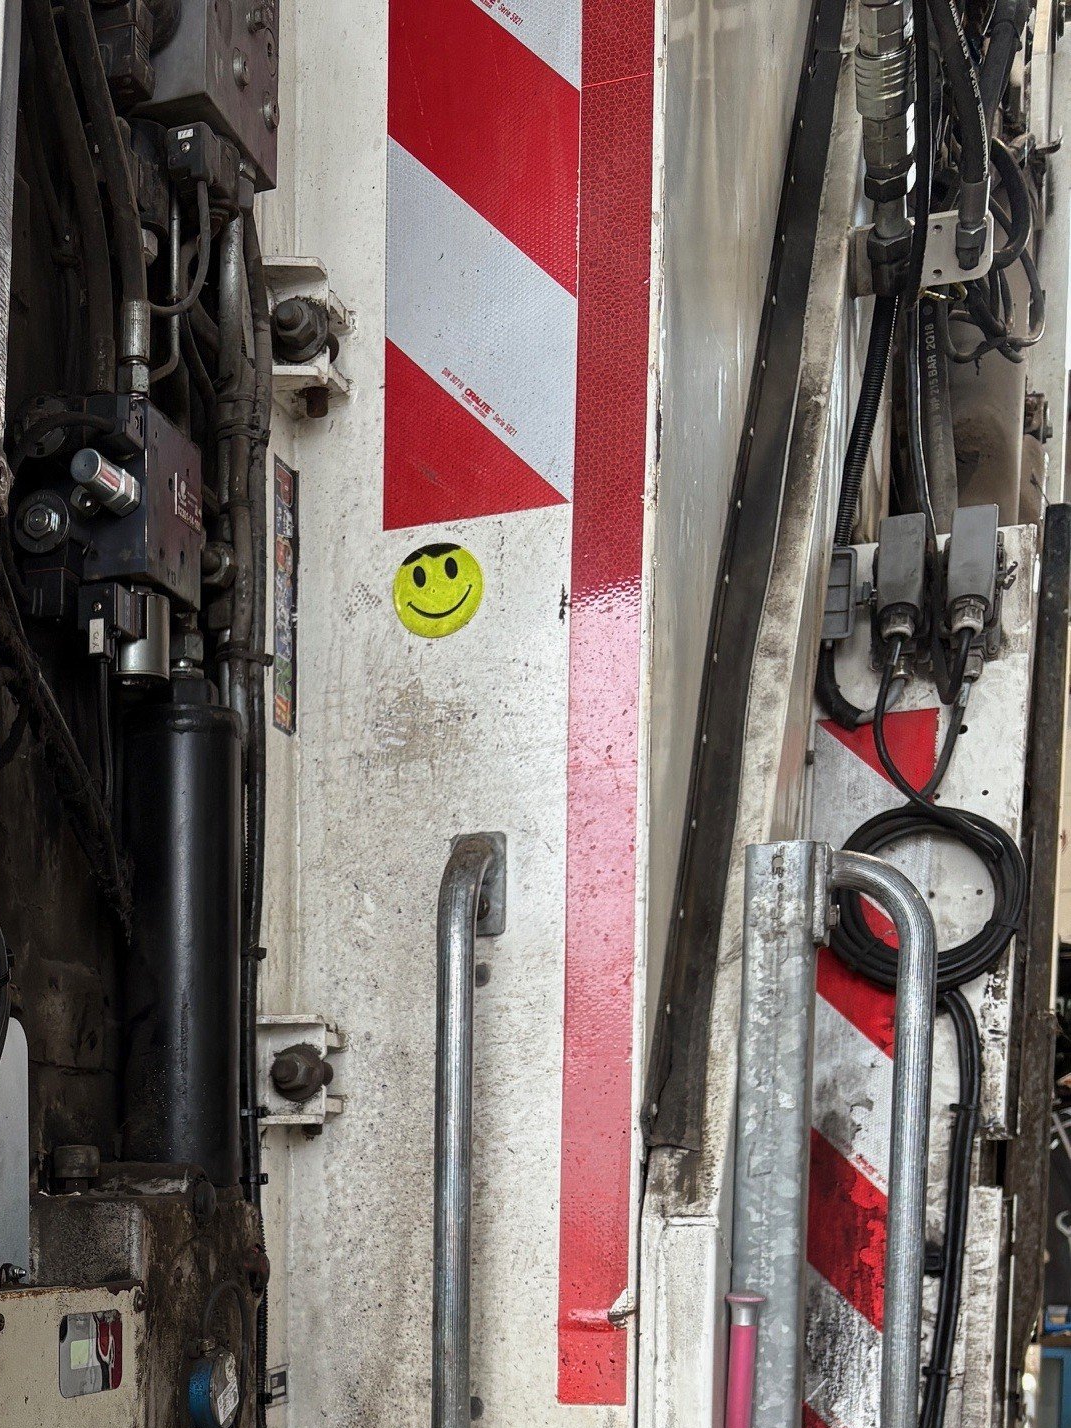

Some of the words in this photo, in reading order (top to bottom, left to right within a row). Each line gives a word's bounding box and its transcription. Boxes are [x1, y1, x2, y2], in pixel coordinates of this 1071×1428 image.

[498, 3, 511, 18] Serie
[924, 323, 936, 351] 2Q18
[927, 354, 938, 378] BAR
[464, 388, 493, 414] ORALITE
[493, 413, 506, 428] Serie
[504, 423, 518, 437] 5821
